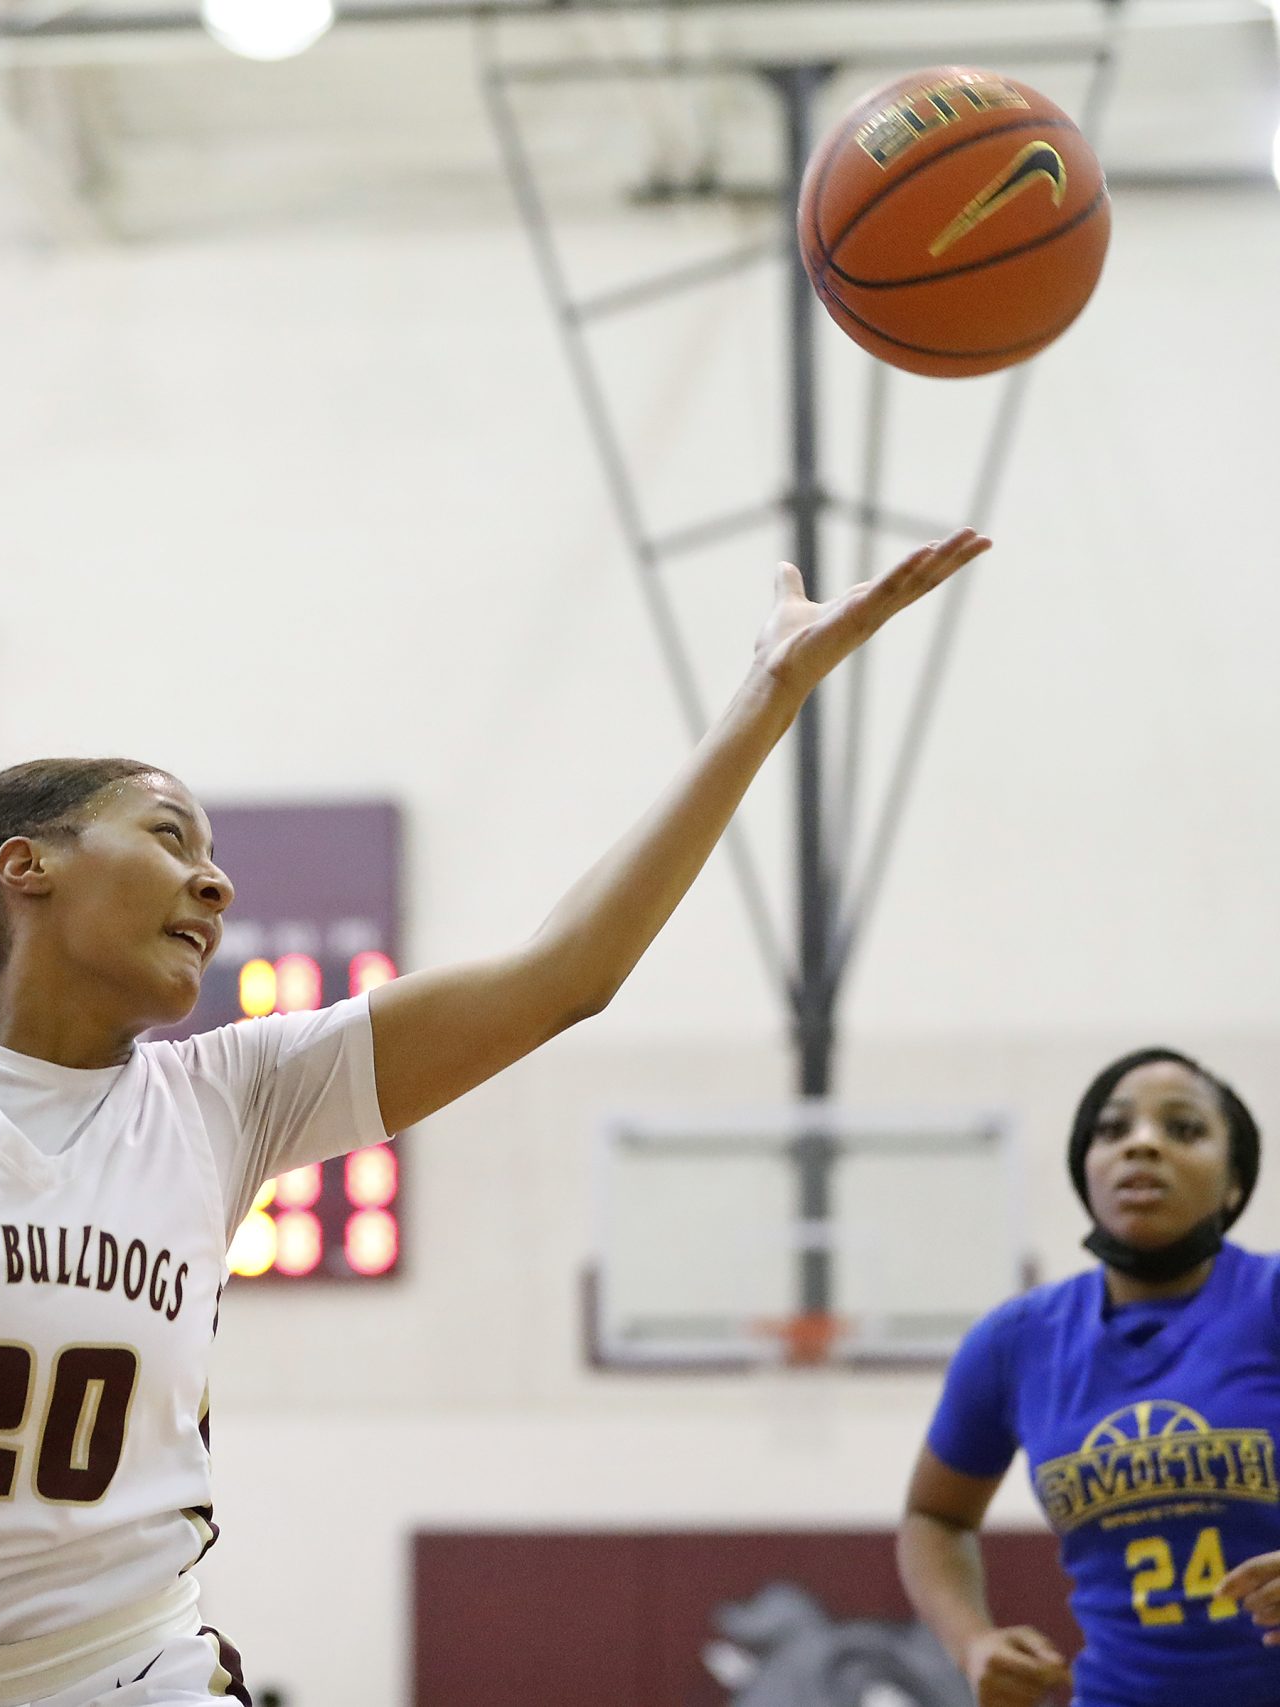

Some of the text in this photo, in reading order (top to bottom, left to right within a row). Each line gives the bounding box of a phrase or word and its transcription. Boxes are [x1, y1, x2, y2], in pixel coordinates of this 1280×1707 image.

[0, 1222, 190, 1322] BULLDOGS
[1037, 1431, 1278, 1526] SMITH
[1124, 1526, 1239, 1627] 24
